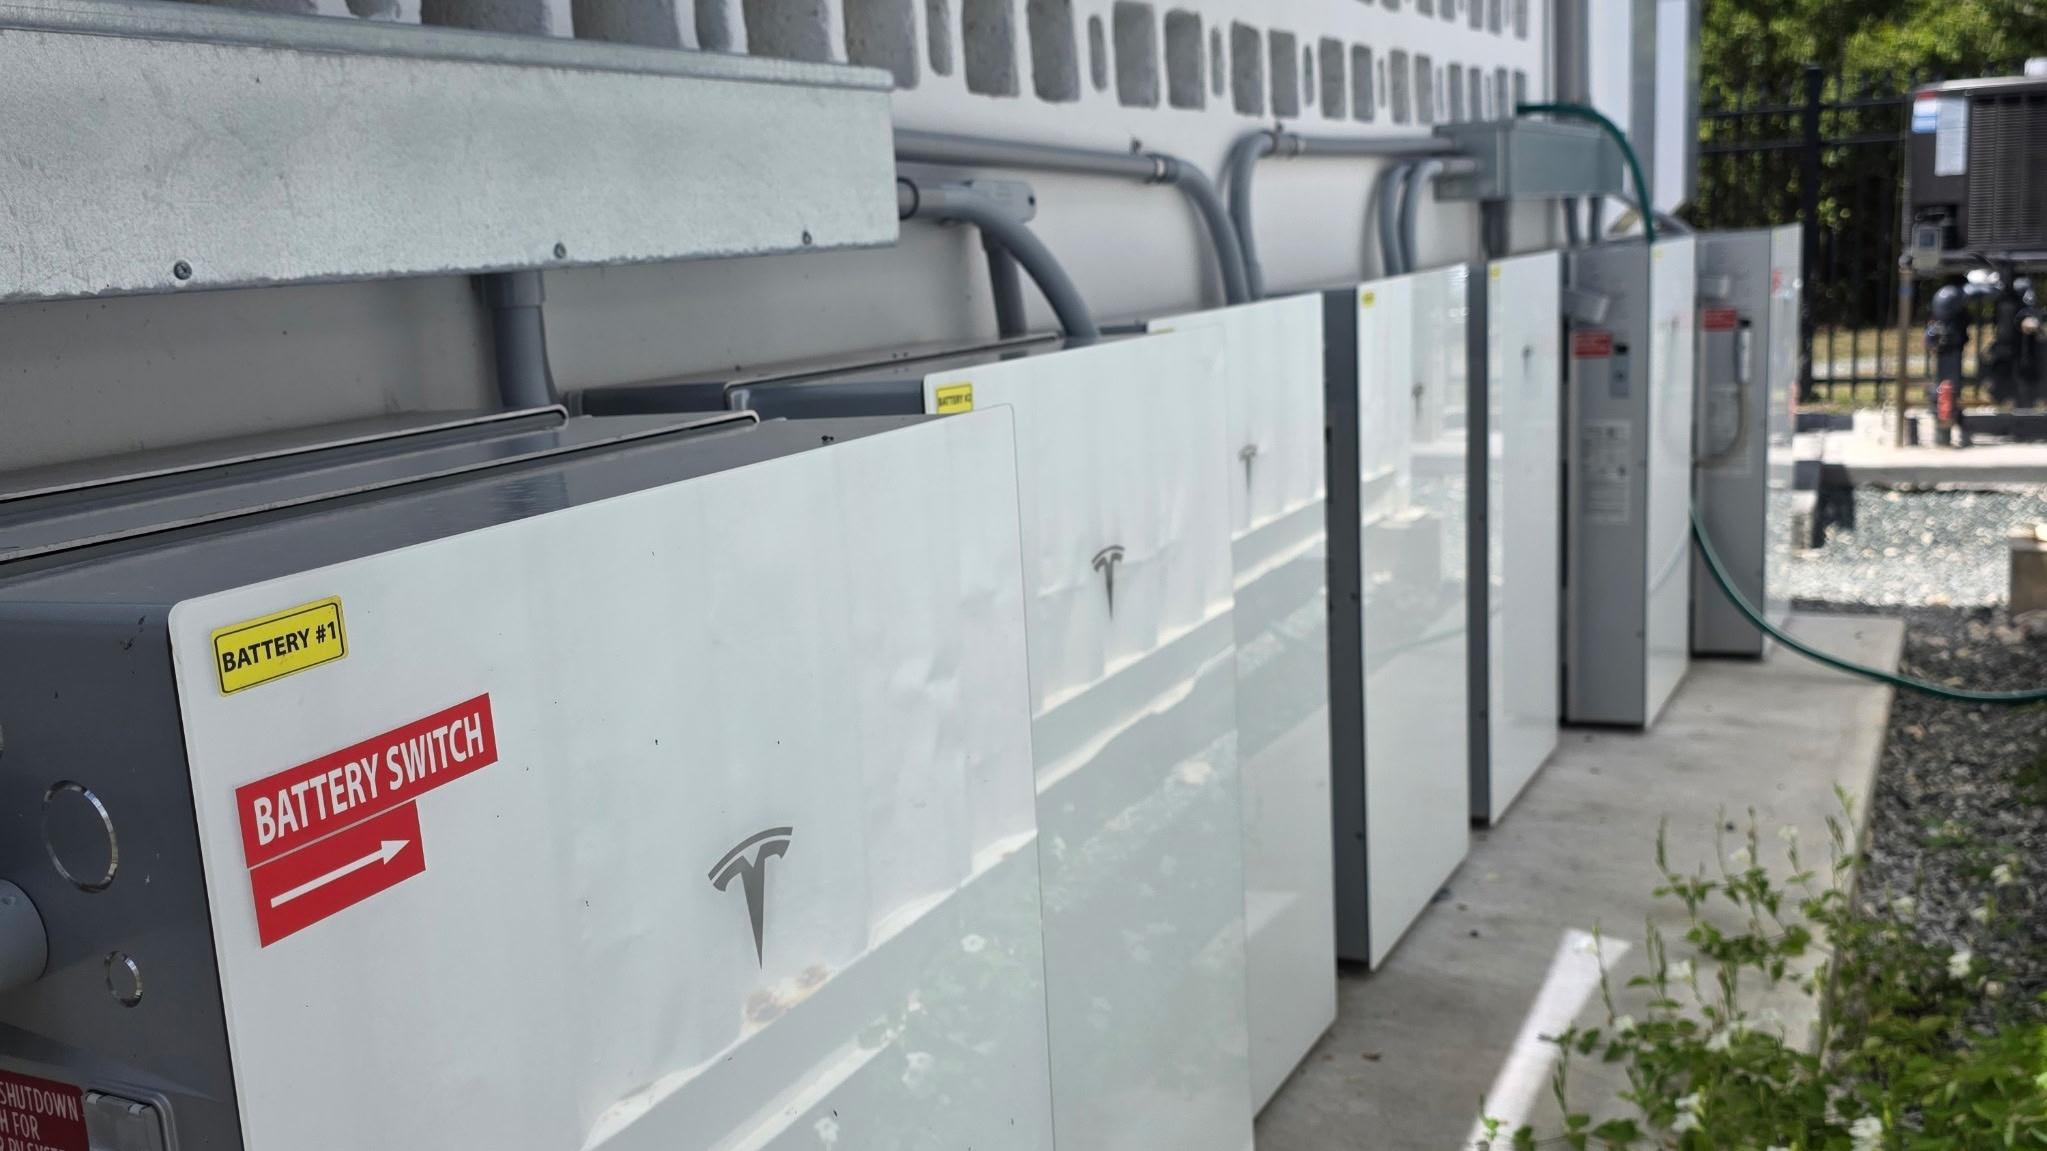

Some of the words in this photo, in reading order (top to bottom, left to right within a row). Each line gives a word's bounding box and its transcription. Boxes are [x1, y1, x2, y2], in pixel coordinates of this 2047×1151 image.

[222, 628, 309, 673] BATTERY
[316, 621, 337, 644] #1
[253, 752, 378, 846] BATTERY
[386, 712, 485, 791] SWITCH
[12, 1111, 41, 1141] FOR
